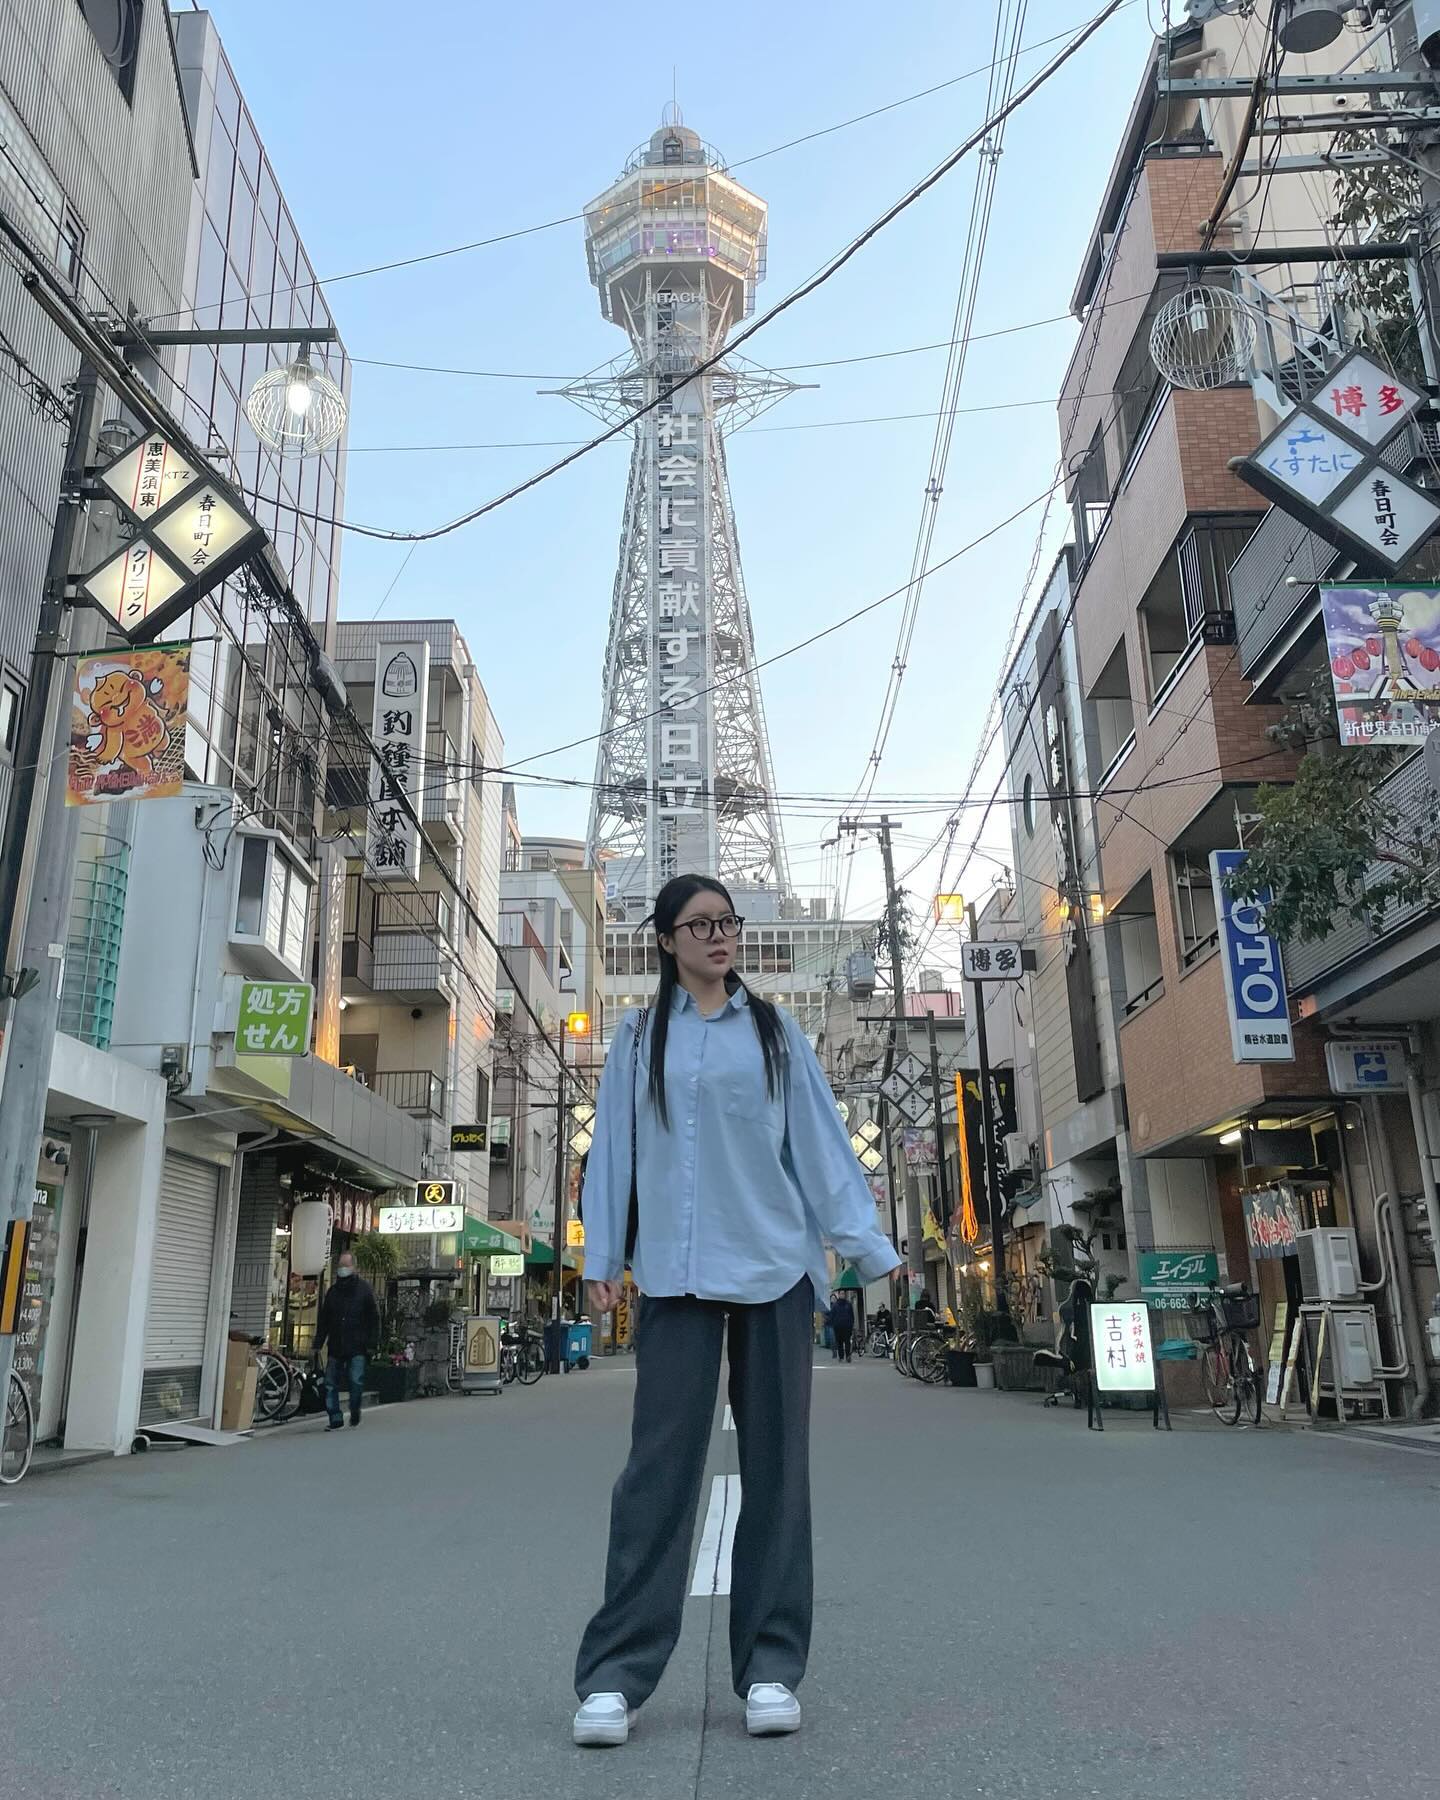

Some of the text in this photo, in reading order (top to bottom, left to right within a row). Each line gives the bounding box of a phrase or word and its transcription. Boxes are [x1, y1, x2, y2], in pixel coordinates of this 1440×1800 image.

[645, 292, 704, 304] HITACH
[1330, 385, 1404, 416] 博多
[139, 442, 165, 506] 恵美須東
[1268, 453, 1355, 476] くすたに
[190, 494, 216, 565] 春日町会
[1371, 479, 1399, 546] 春日町会
[126, 549, 147, 616] クリニック
[657, 413, 704, 814] 社会に貢献する日立
[969, 947, 1017, 971] 博多
[1226, 866, 1279, 1013] OTO
[247, 988, 305, 1016] 処方
[243, 1023, 298, 1049] せん
[1151, 1254, 1207, 1280] エイブル
[1105, 1315, 1127, 1369] 吉村
[1131, 1312, 1147, 1363] お好み焼
